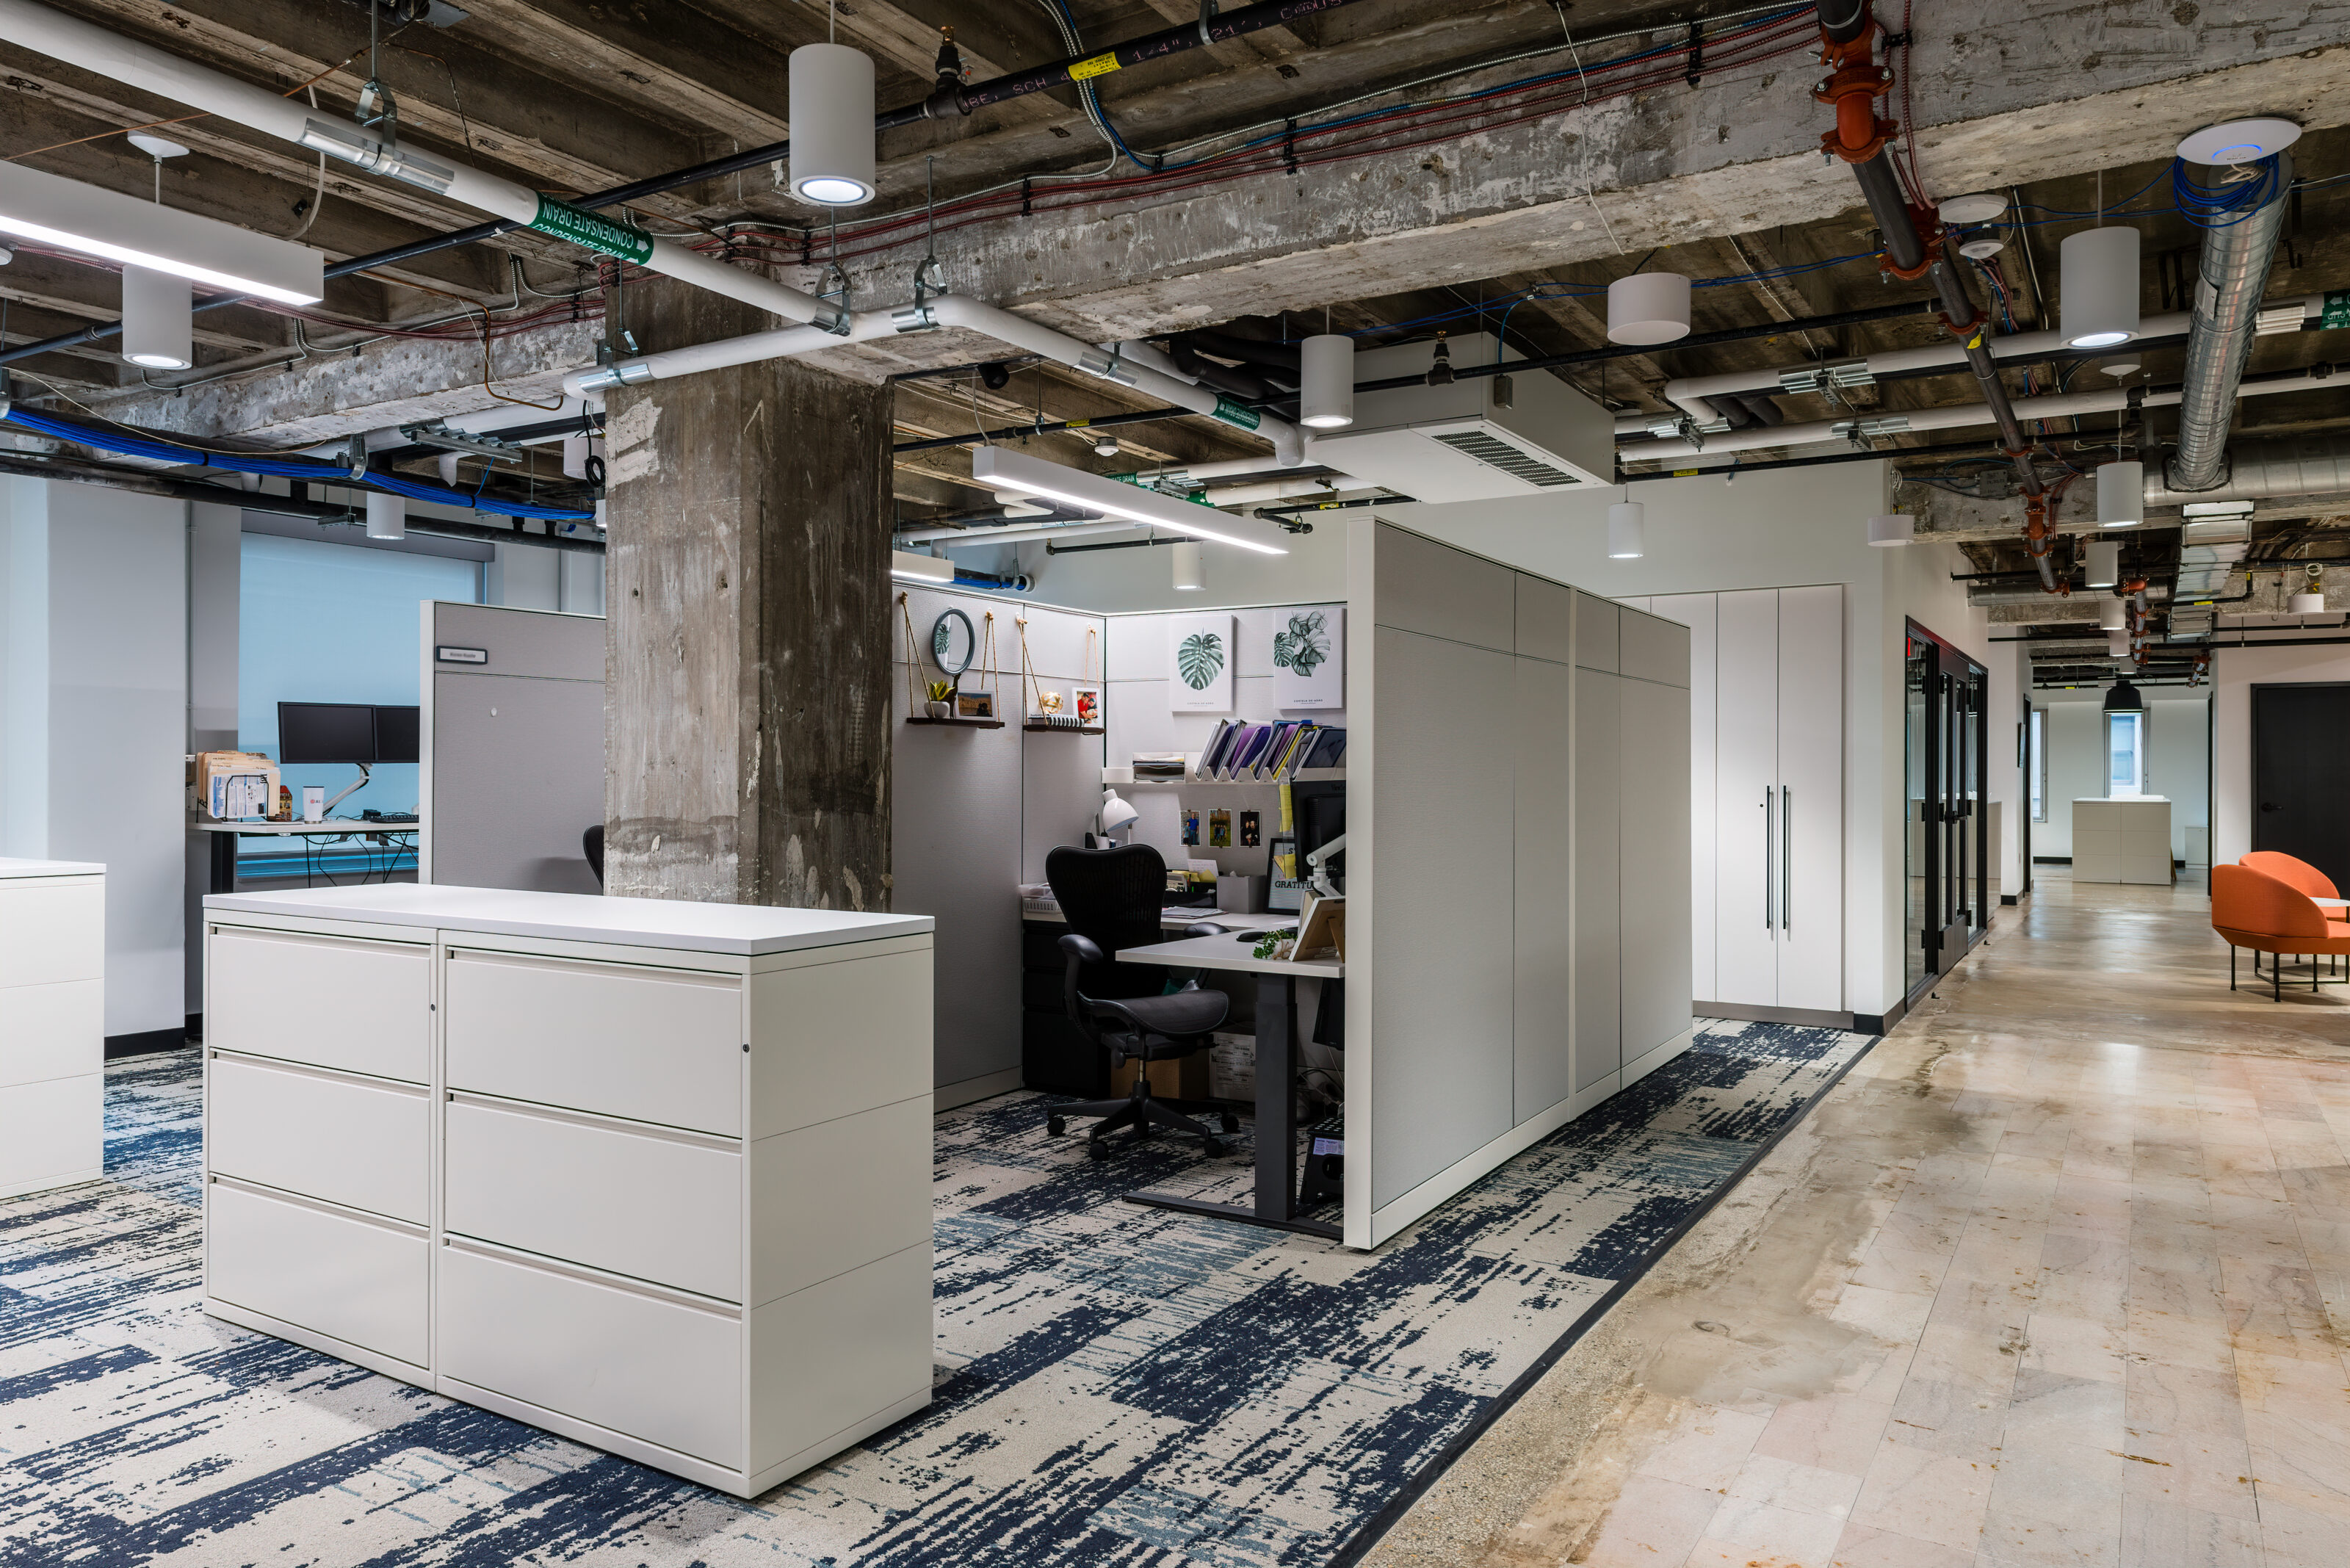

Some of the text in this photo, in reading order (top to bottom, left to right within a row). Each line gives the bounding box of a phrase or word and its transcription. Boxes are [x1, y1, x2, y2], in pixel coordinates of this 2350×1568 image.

[1013, 77, 1047, 95] SCH
[1060, 71, 1071, 82] 4
[542, 202, 573, 227] DRAIN
[573, 213, 634, 249] CONDENSATE
[1274, 881, 1312, 889] GRATITU
